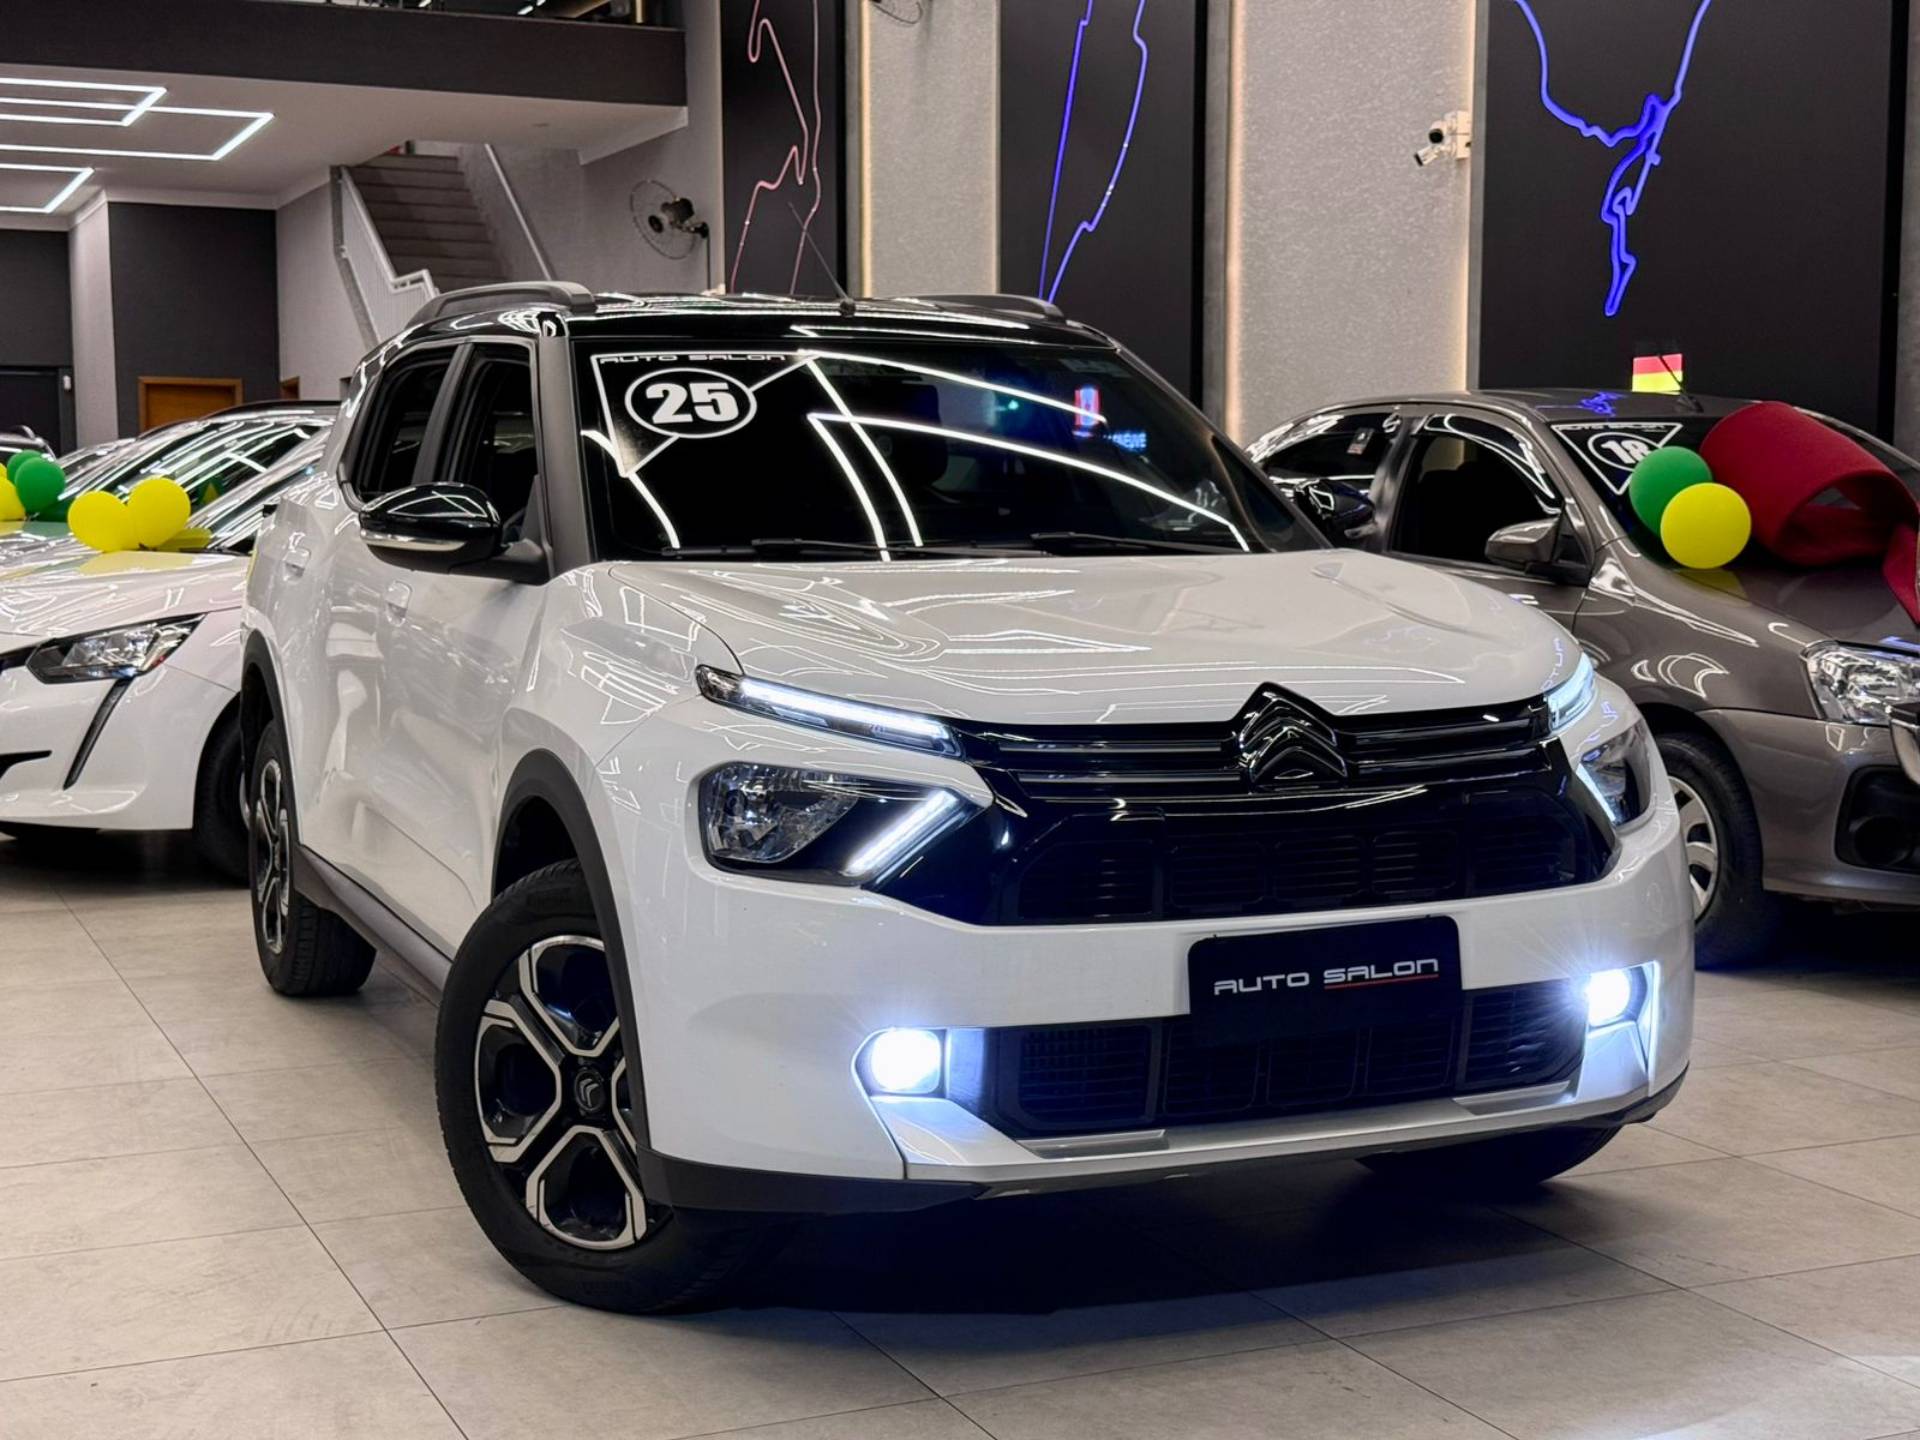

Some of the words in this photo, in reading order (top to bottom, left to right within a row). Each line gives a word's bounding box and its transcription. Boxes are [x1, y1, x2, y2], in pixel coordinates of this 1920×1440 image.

[600, 354, 678, 364] AUTO
[688, 353, 785, 362] SALON
[645, 382, 740, 424] 25
[1214, 972, 1310, 995] AUTO
[1323, 958, 1439, 984] SALON
